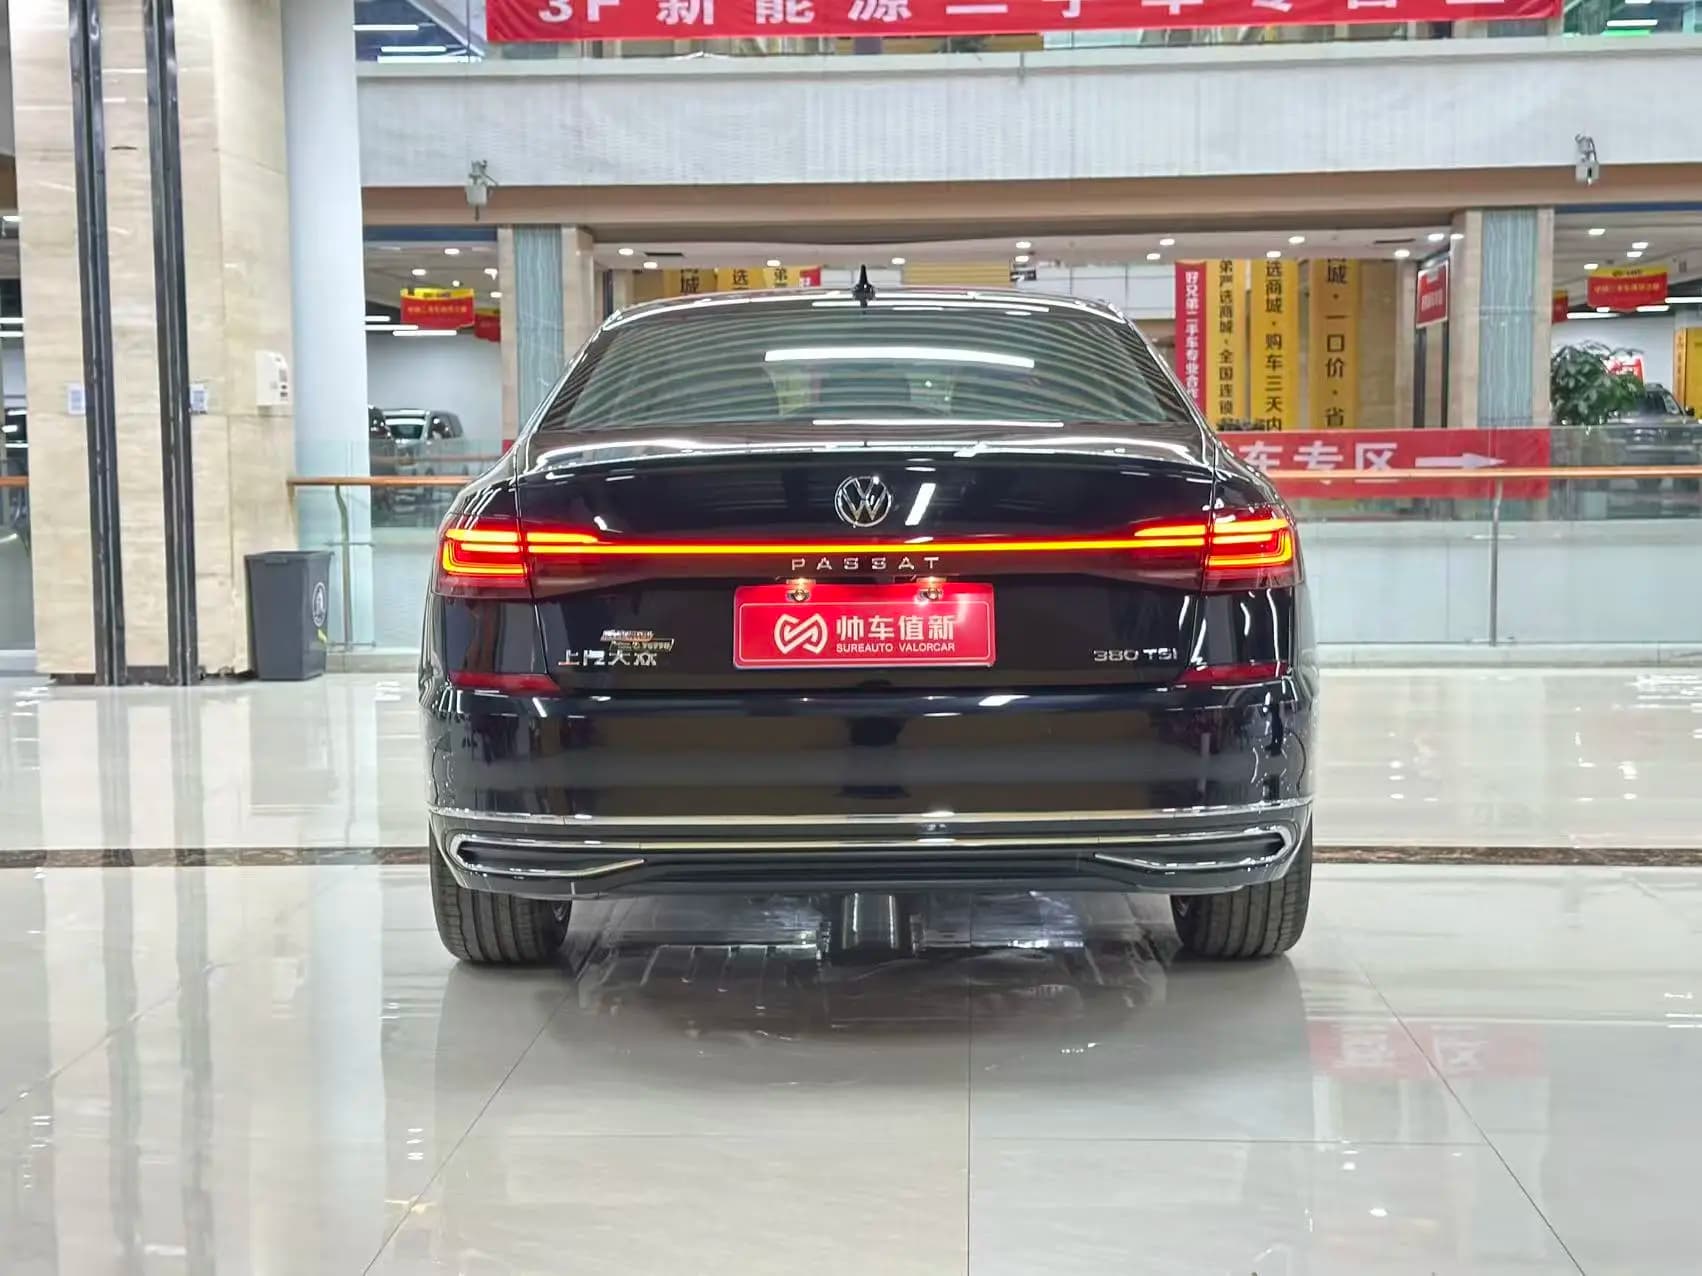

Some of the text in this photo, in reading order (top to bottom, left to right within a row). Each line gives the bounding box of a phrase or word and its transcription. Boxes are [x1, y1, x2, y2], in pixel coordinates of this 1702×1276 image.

[1239, 440, 1399, 484] 车专区
[791, 556, 940, 571] PASSAT
[836, 614, 956, 642] 帅车值新
[836, 643, 956, 653] SUREAUTO VALORCAR
[1093, 648, 1177, 661] 380 TSI
